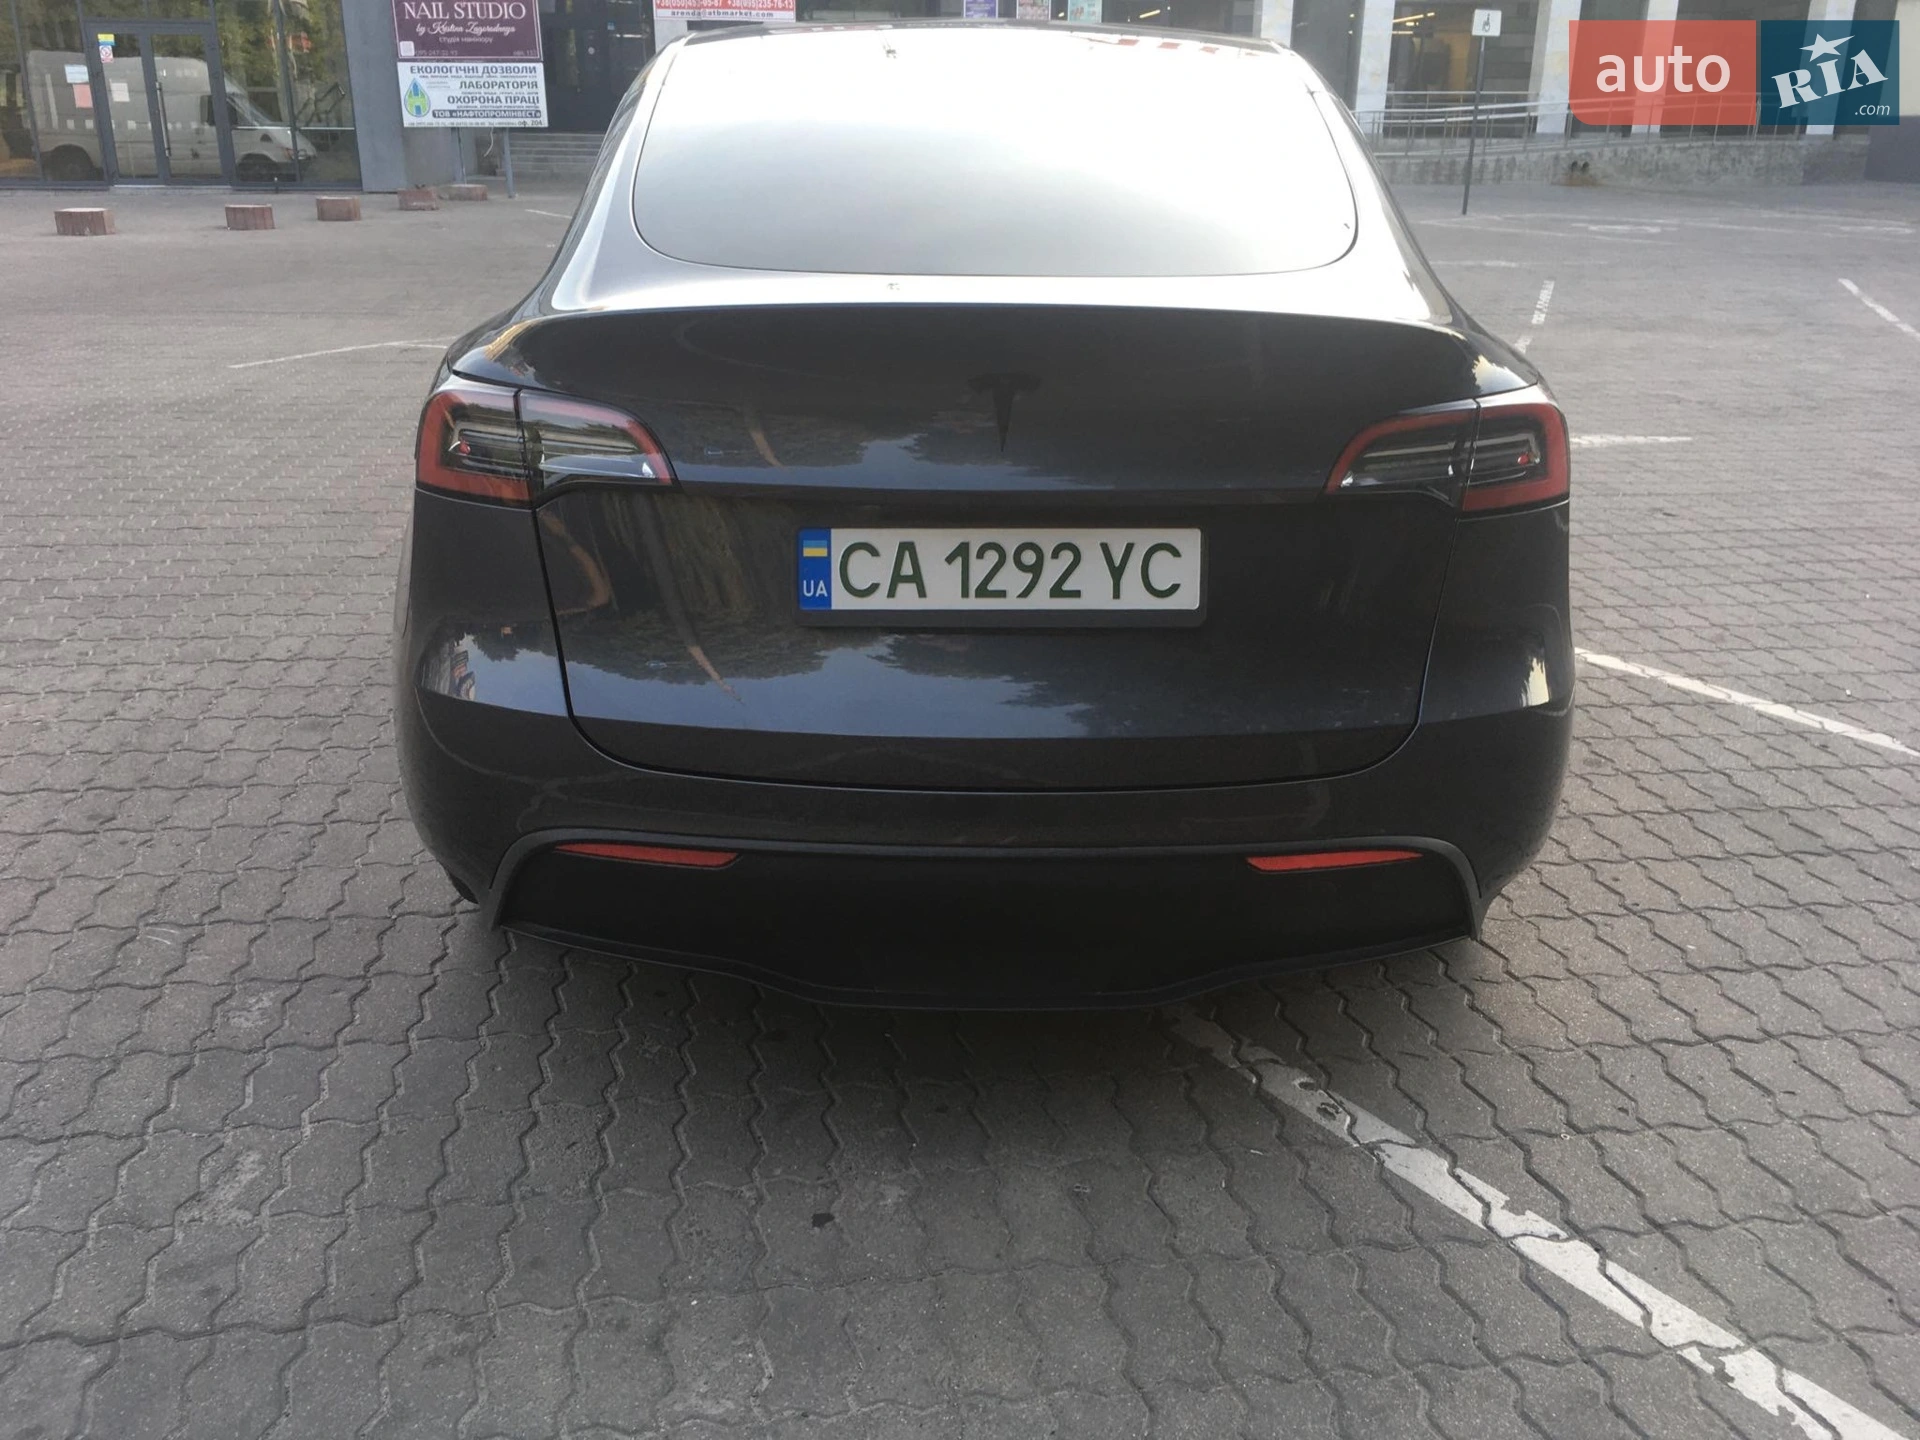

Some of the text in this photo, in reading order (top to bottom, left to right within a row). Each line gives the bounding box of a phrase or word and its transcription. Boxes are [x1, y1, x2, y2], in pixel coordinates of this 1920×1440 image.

[404, 2, 526, 20] NAIL STUDIO
[416, 23, 426, 36] by
[410, 65, 537, 76] ЕКОЛОГІЧНІ ДОЗВОЛИ
[459, 80, 539, 90] ЛАБОРАТОРІЯ
[447, 95, 540, 105] ОХОРОНА ПРАЦІ
[838, 541, 1182, 600] CA 1292 YC
[803, 580, 828, 597] UA
